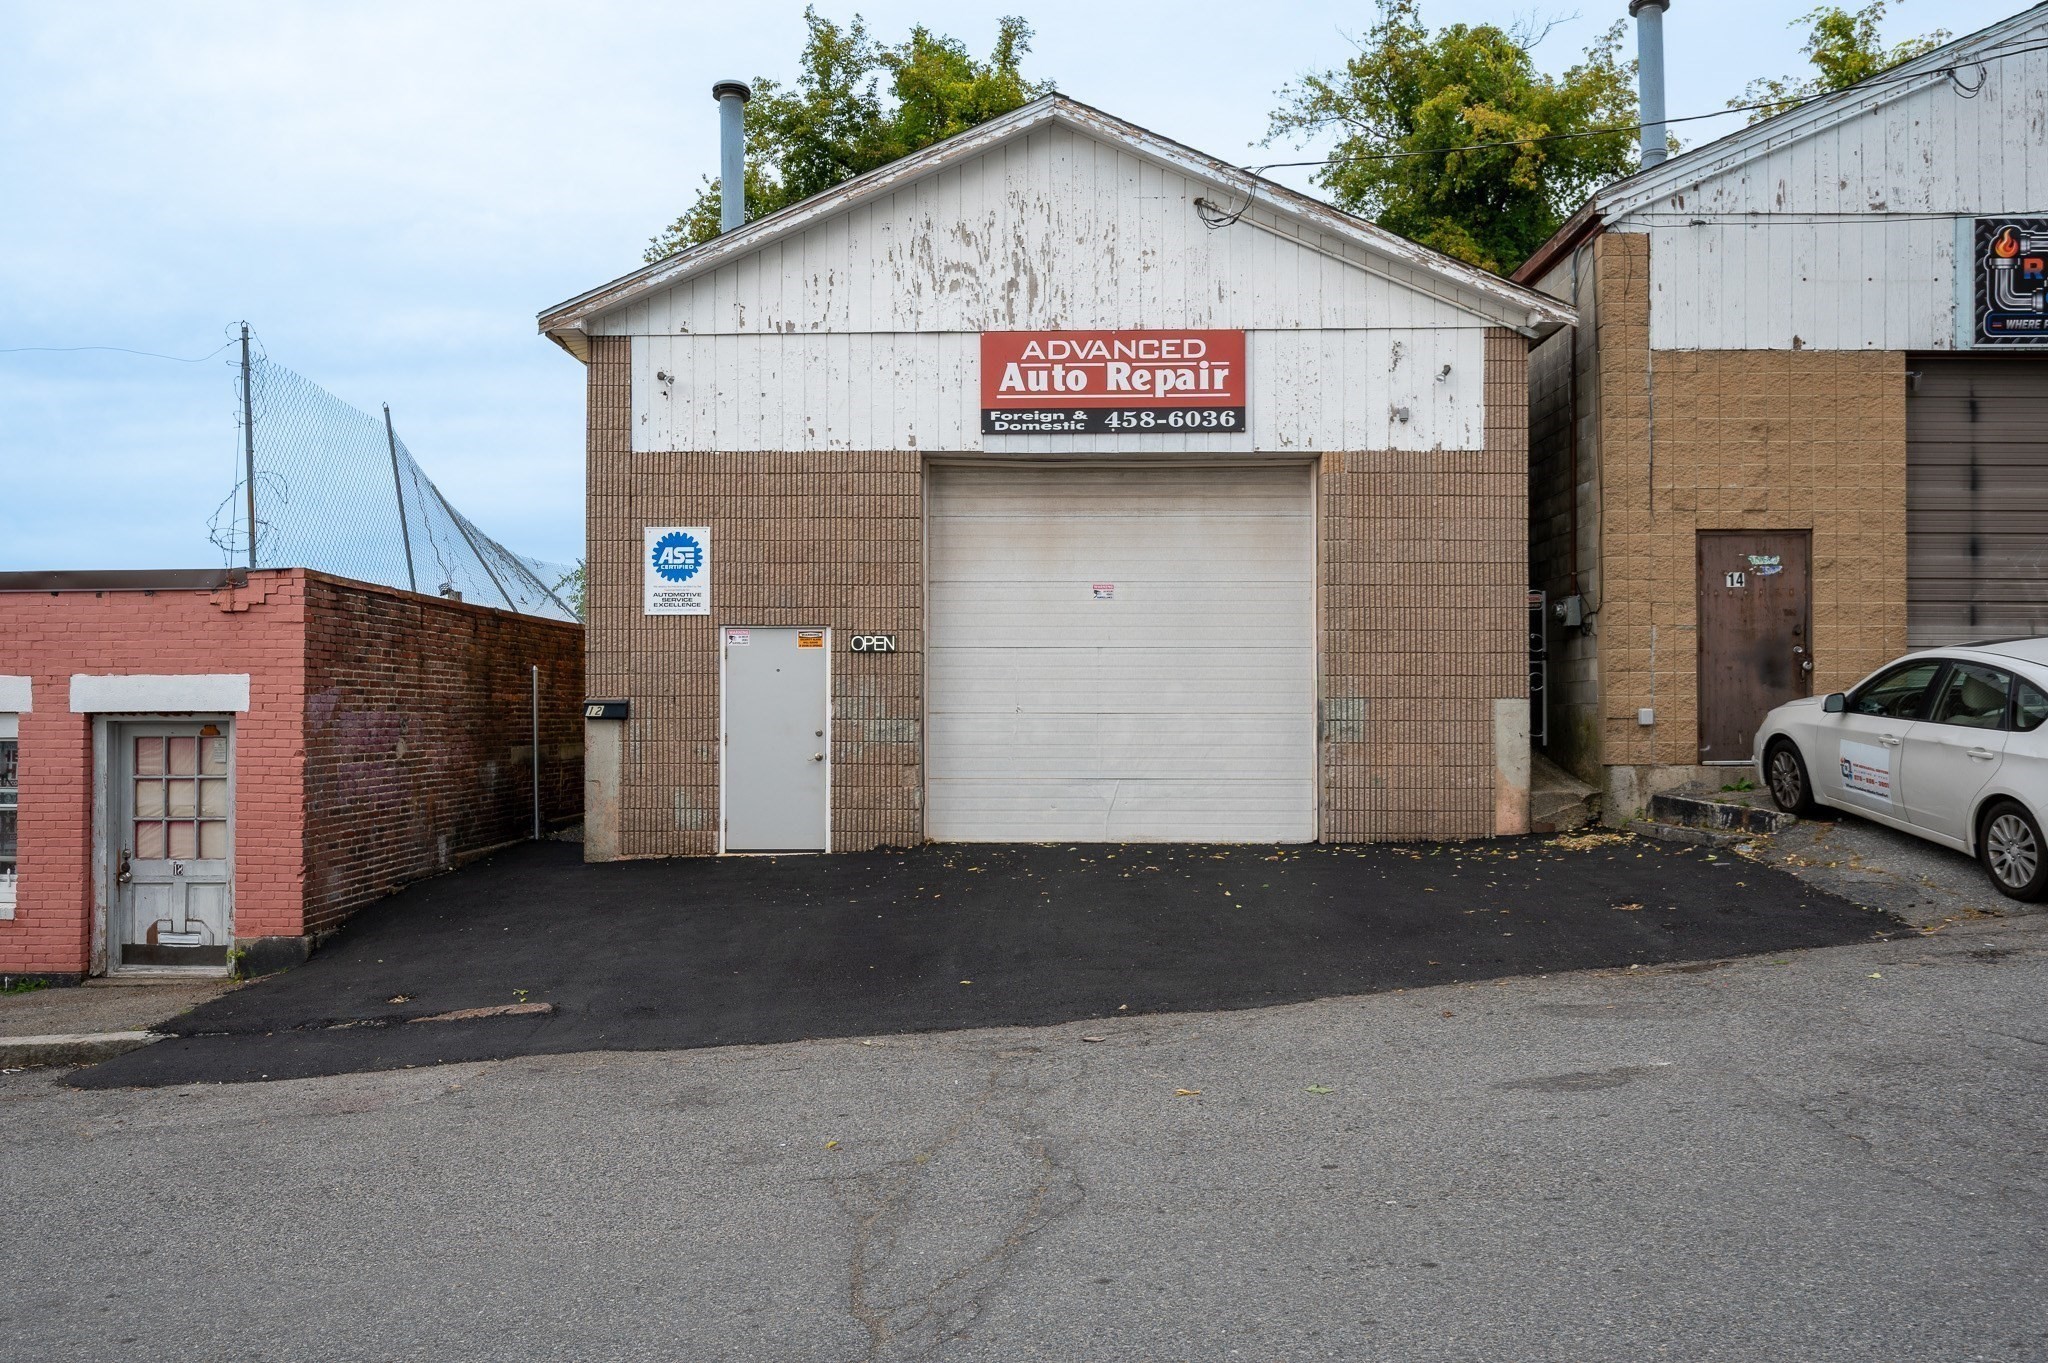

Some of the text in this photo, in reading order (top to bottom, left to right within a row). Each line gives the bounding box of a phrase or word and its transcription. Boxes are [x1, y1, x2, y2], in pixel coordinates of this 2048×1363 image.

[2006, 319, 2042, 329] WHERE
[1020, 339, 1207, 360] ADVANCED
[999, 360, 1230, 398] Auto Repair
[990, 410, 1088, 422] Foreign &
[1104, 410, 1236, 429] 458-6036
[994, 421, 1085, 431] Domestic
[657, 546, 695, 565] ASE
[1728, 572, 1744, 587] 14
[851, 635, 895, 651] OPEN
[588, 706, 603, 716] 12
